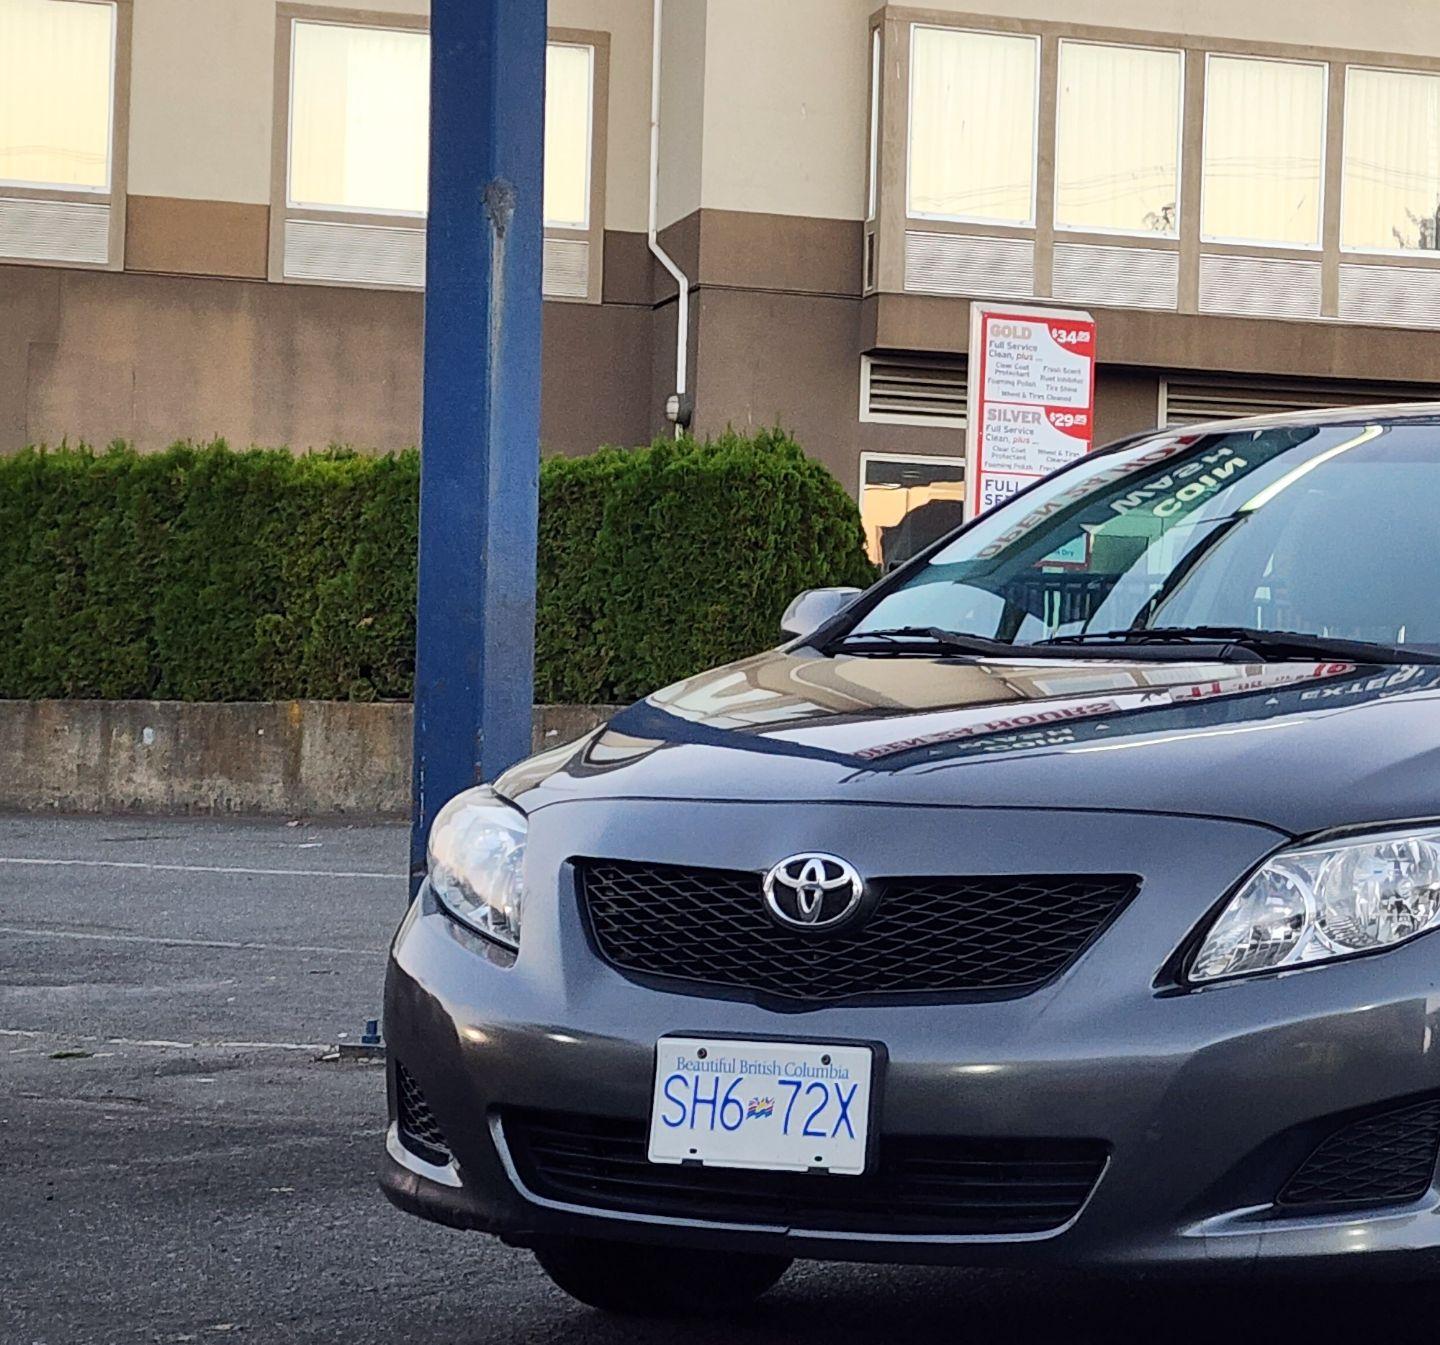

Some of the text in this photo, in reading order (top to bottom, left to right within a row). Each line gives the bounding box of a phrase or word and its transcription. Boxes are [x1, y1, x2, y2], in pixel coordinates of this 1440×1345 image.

[990, 324, 1032, 340] GOLD
[989, 341, 1039, 352] Full Service
[1016, 352, 1034, 361] plus
[988, 409, 1042, 424] SILVER
[985, 424, 1034, 436] Full Service
[1013, 437, 1030, 445] plus
[676, 1056, 849, 1080] Beautiful British Columbia
[662, 1074, 858, 1140] SH6 72X
